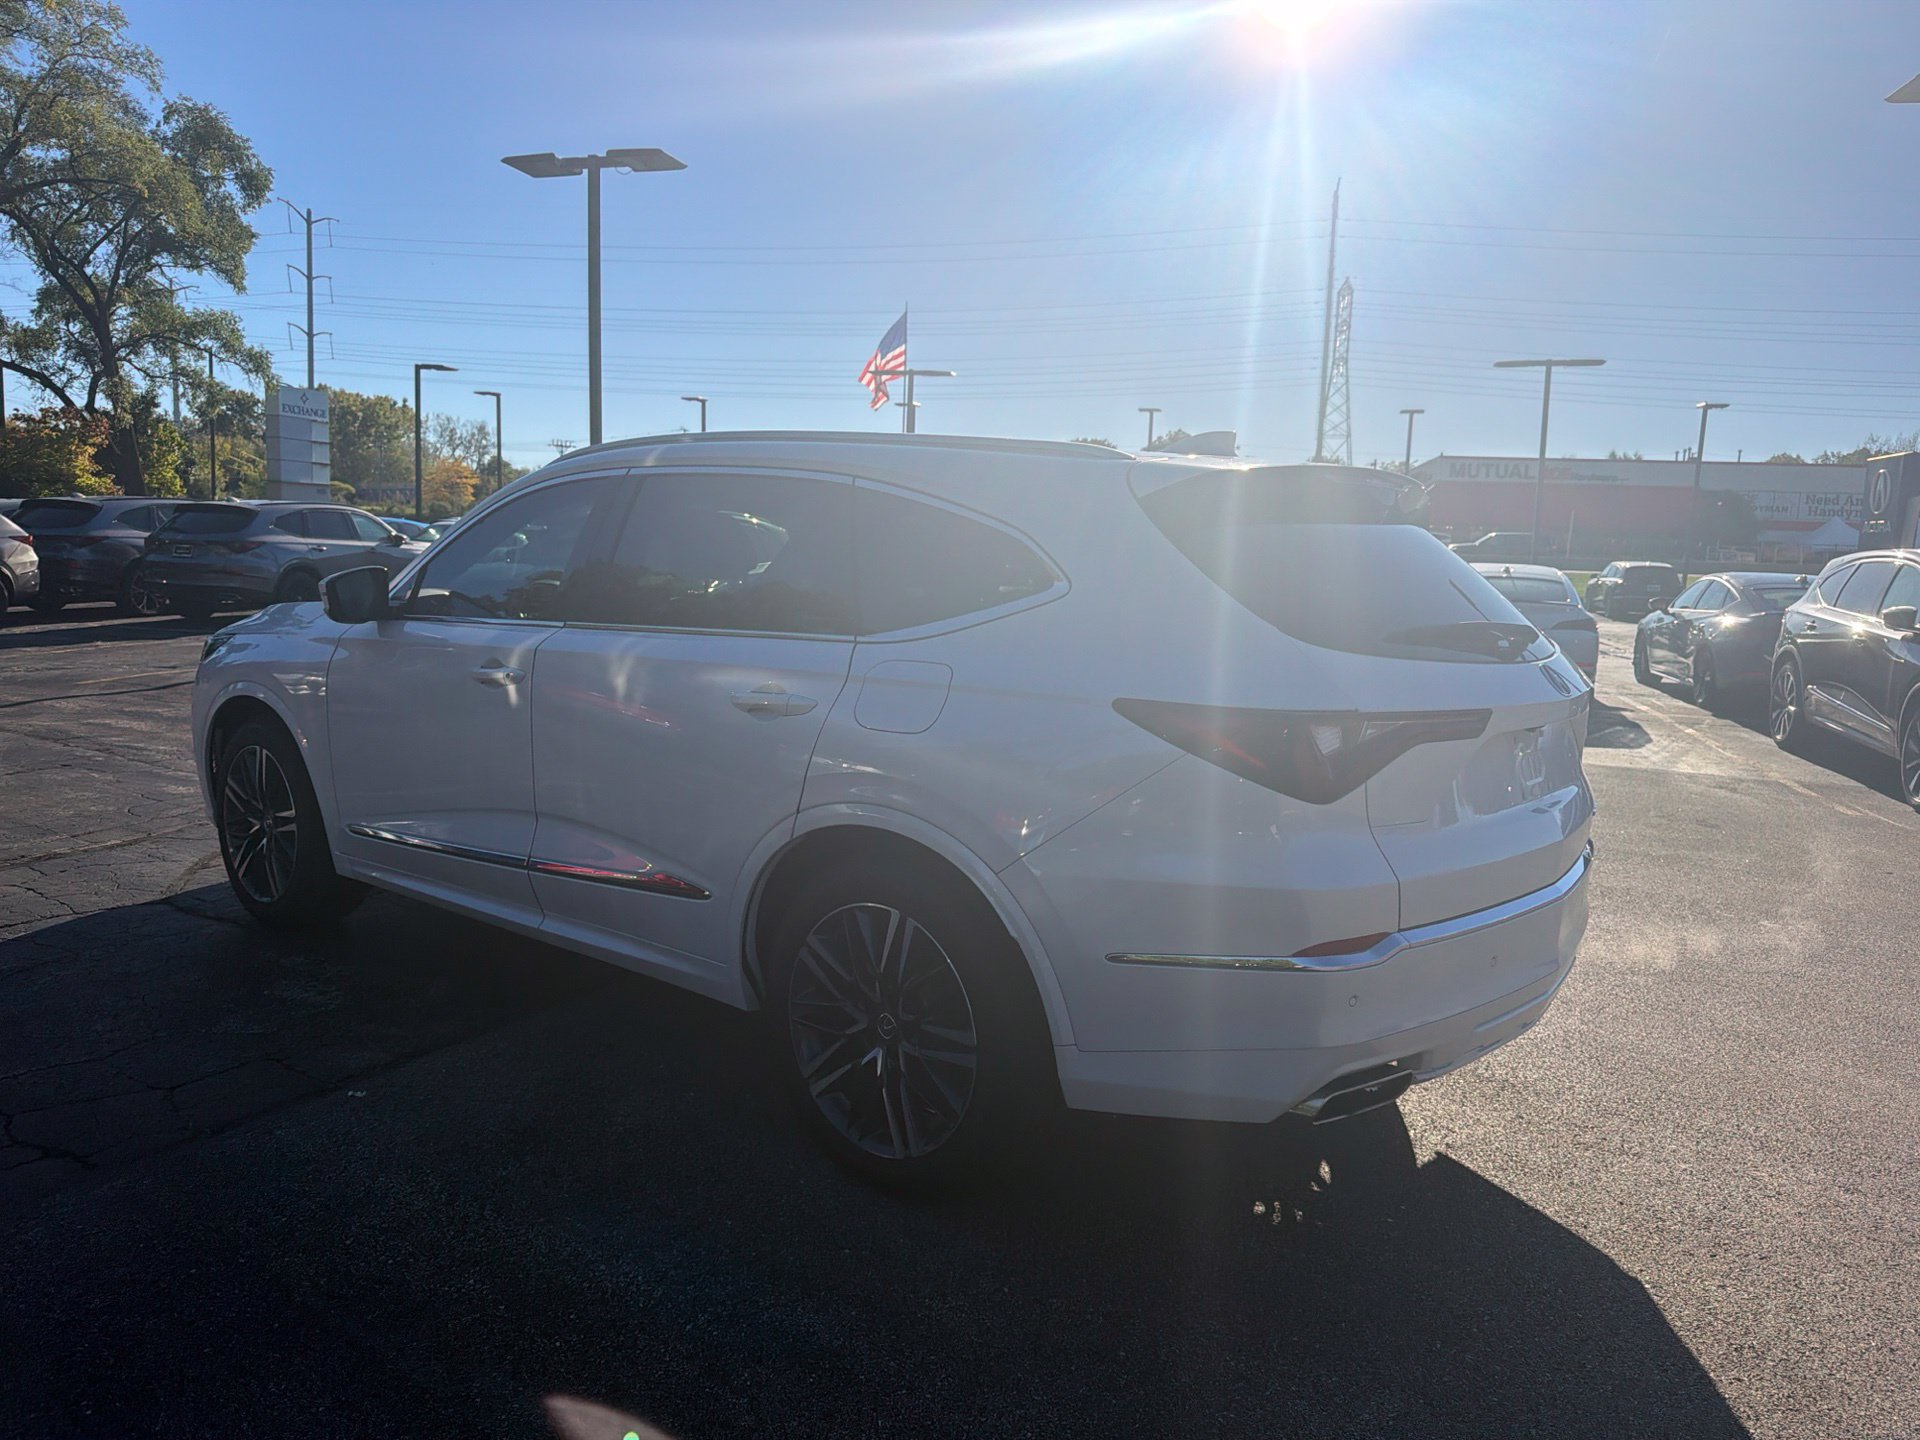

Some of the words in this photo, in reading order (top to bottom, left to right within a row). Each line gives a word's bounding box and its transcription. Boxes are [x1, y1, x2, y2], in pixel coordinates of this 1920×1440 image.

[281, 403, 327, 419] EXCHANGE
[1449, 462, 1536, 479] MUTUAL
[1805, 494, 1840, 505] Need
